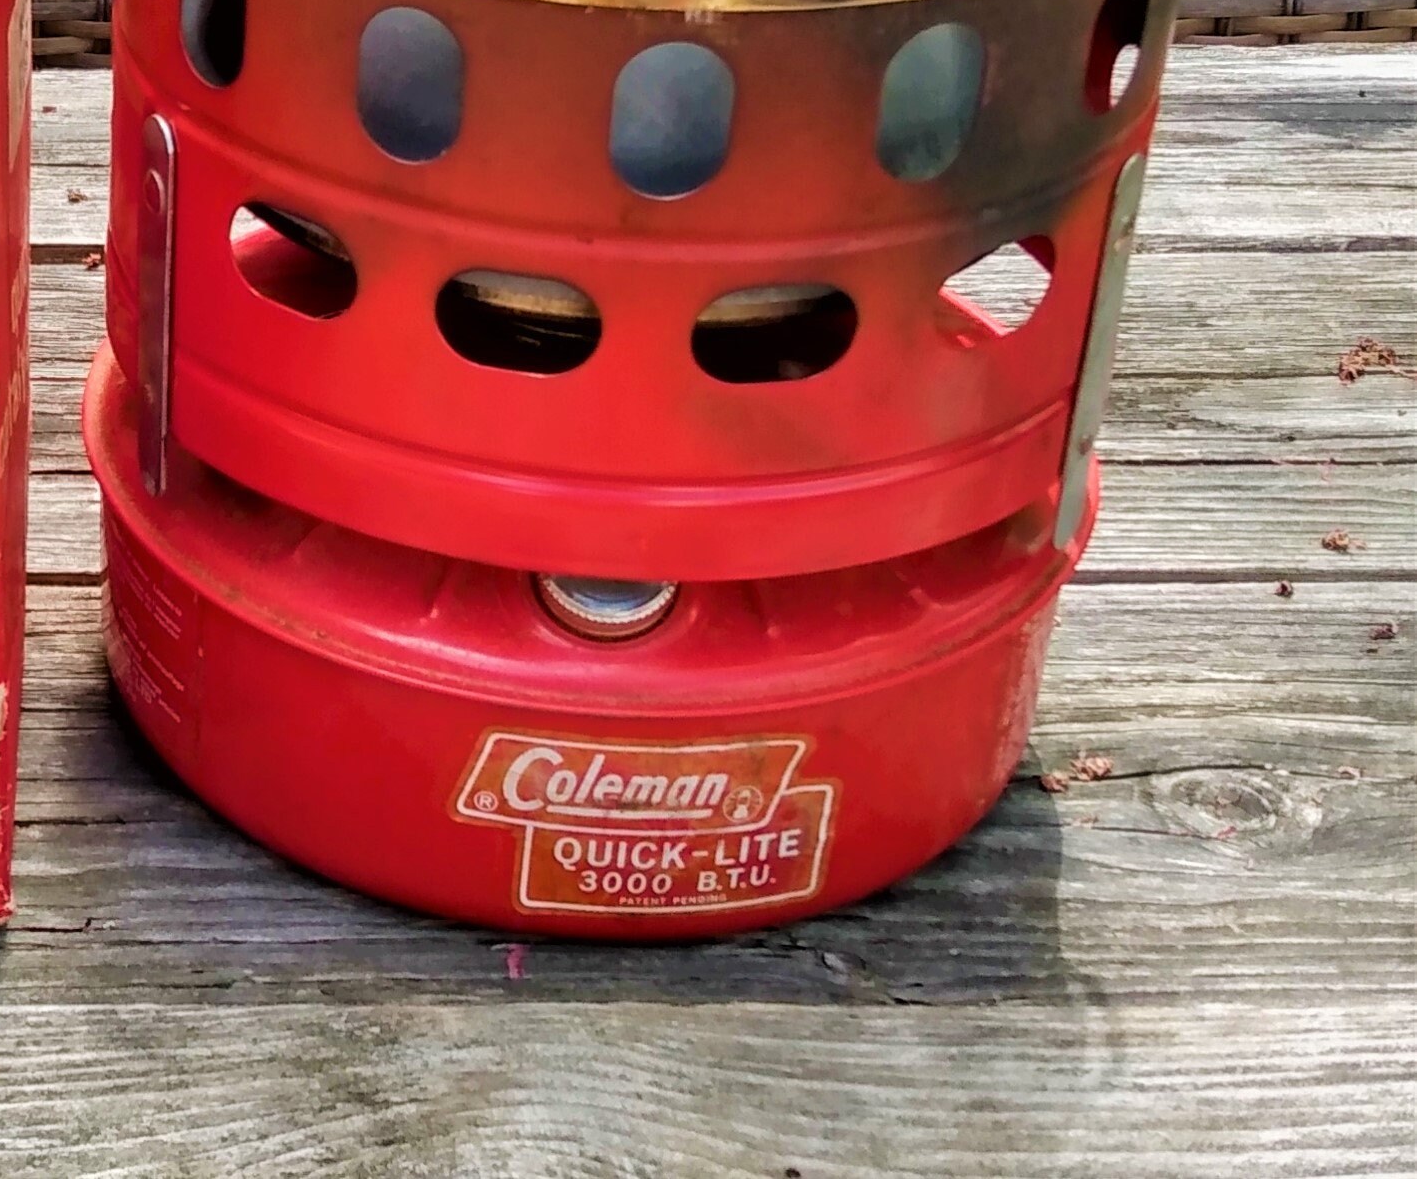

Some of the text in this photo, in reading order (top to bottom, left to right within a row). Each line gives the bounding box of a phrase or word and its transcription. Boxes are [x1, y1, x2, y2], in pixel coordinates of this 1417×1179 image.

[502, 747, 729, 819] Coleman
[553, 828, 803, 872] QUICK-LITE
[578, 864, 777, 894] 3000 B.T.U.
[619, 893, 728, 905] PATENT PENDING
